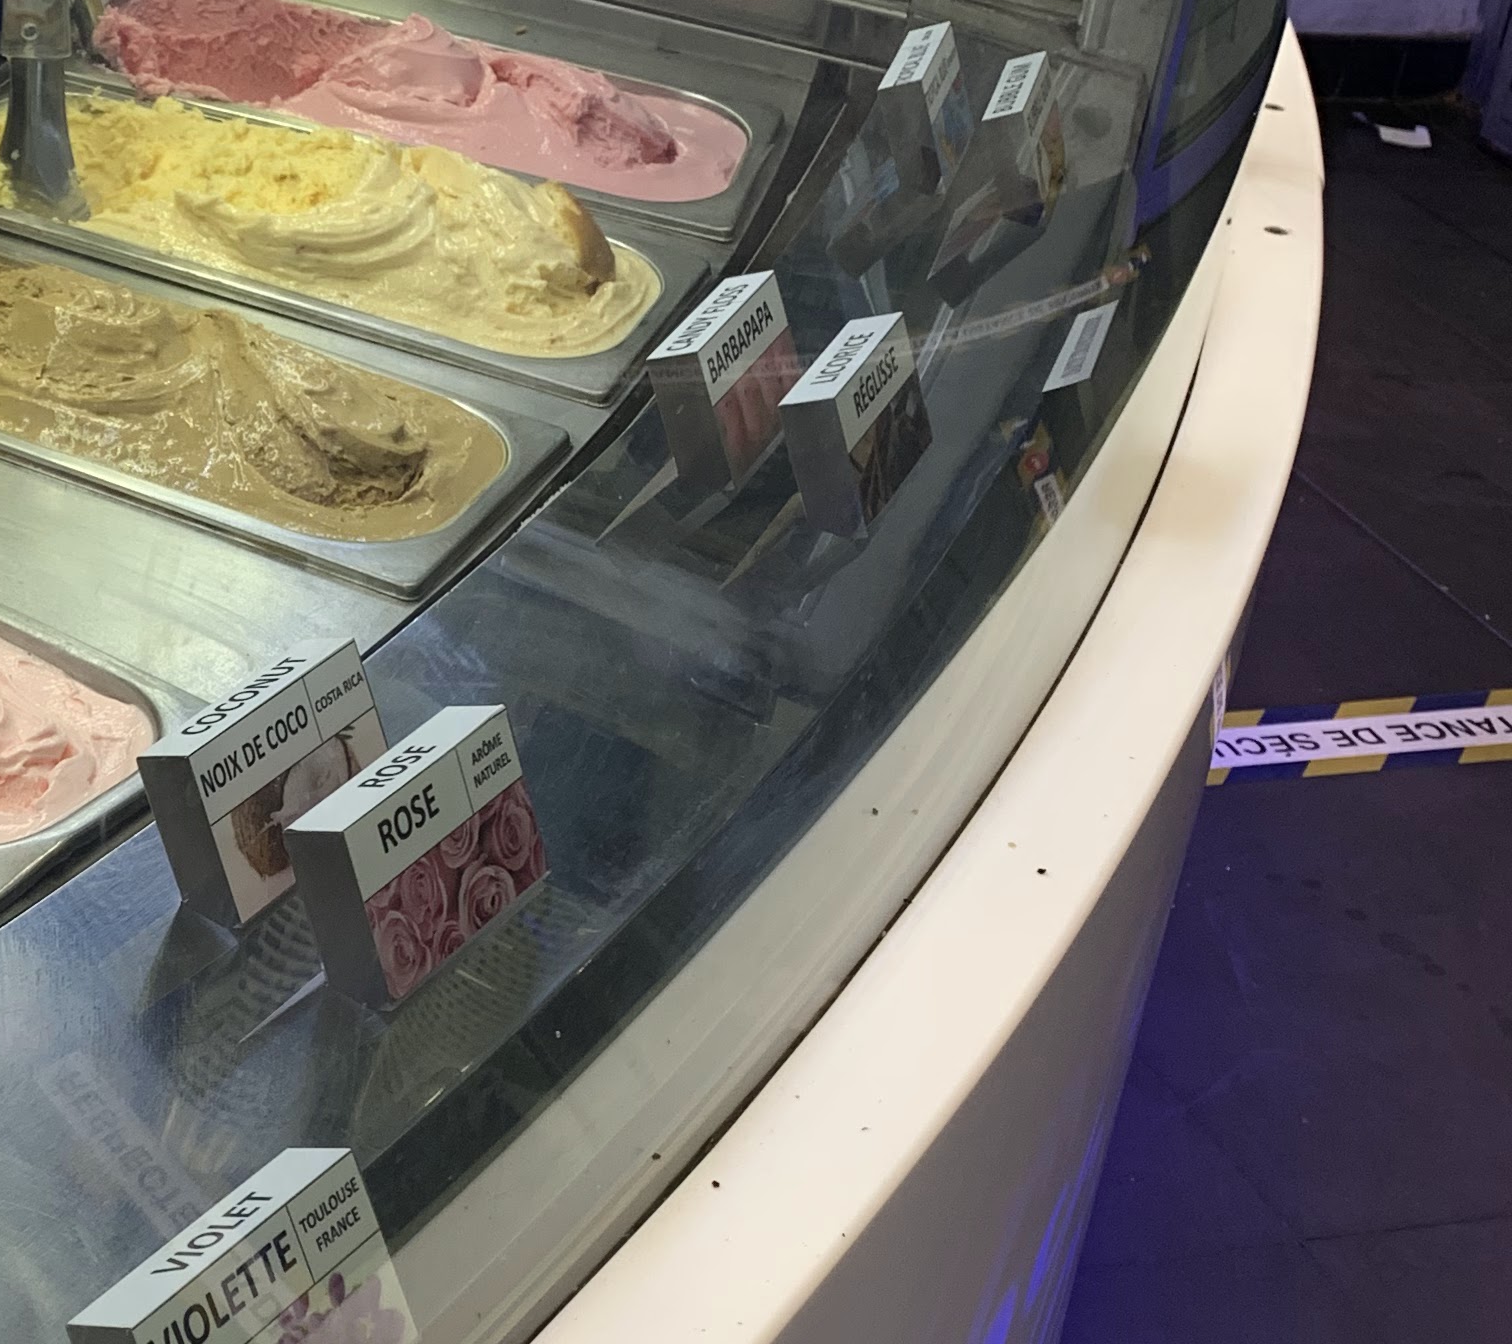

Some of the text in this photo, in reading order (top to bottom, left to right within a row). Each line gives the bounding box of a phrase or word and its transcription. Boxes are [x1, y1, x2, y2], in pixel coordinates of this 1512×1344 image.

[666, 283, 749, 352] CANDY FLOSS
[706, 300, 774, 384] BARBAPAPA
[809, 330, 876, 386] LICORICE
[852, 346, 900, 419] RÉGLISSE
[181, 656, 308, 736] COCONUT
[314, 671, 365, 714] COSTA RICA
[199, 703, 309, 798] NOIX DE COCO
[471, 731, 504, 766] ARÔME
[1323, 726, 1387, 748] DE
[358, 744, 437, 789] ROSE
[473, 752, 513, 790] NATUREL
[377, 783, 440, 854] ROSE
[150, 1191, 273, 1276] VIOLET
[299, 1176, 361, 1234] TOULOUSE
[314, 1206, 362, 1253] FRANCE
